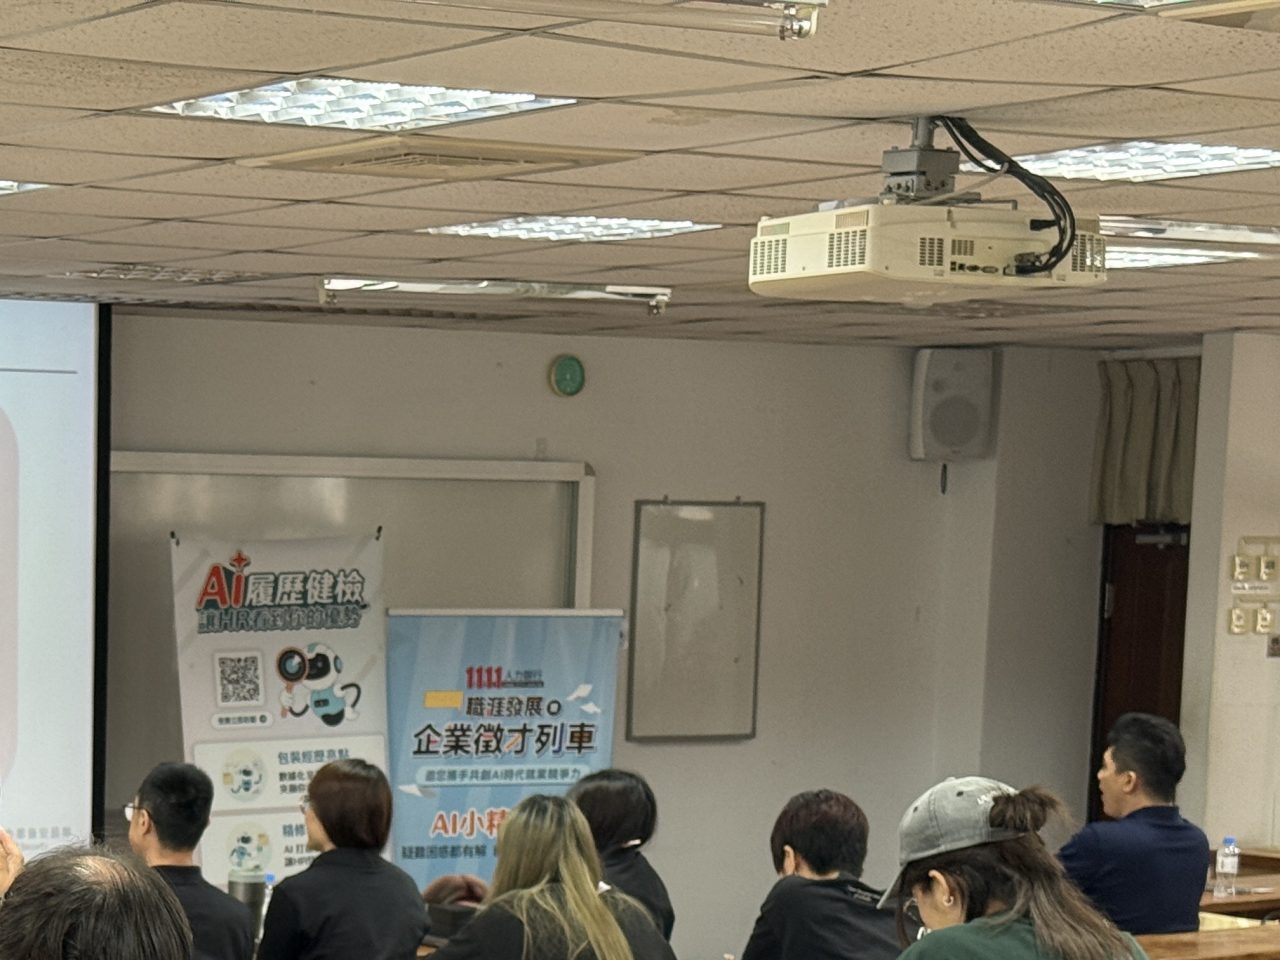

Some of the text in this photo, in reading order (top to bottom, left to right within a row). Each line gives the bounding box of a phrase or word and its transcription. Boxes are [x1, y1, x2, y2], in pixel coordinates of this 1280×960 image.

[466, 665, 502, 688] 1111
[413, 723, 597, 757] 企業徵才列車
